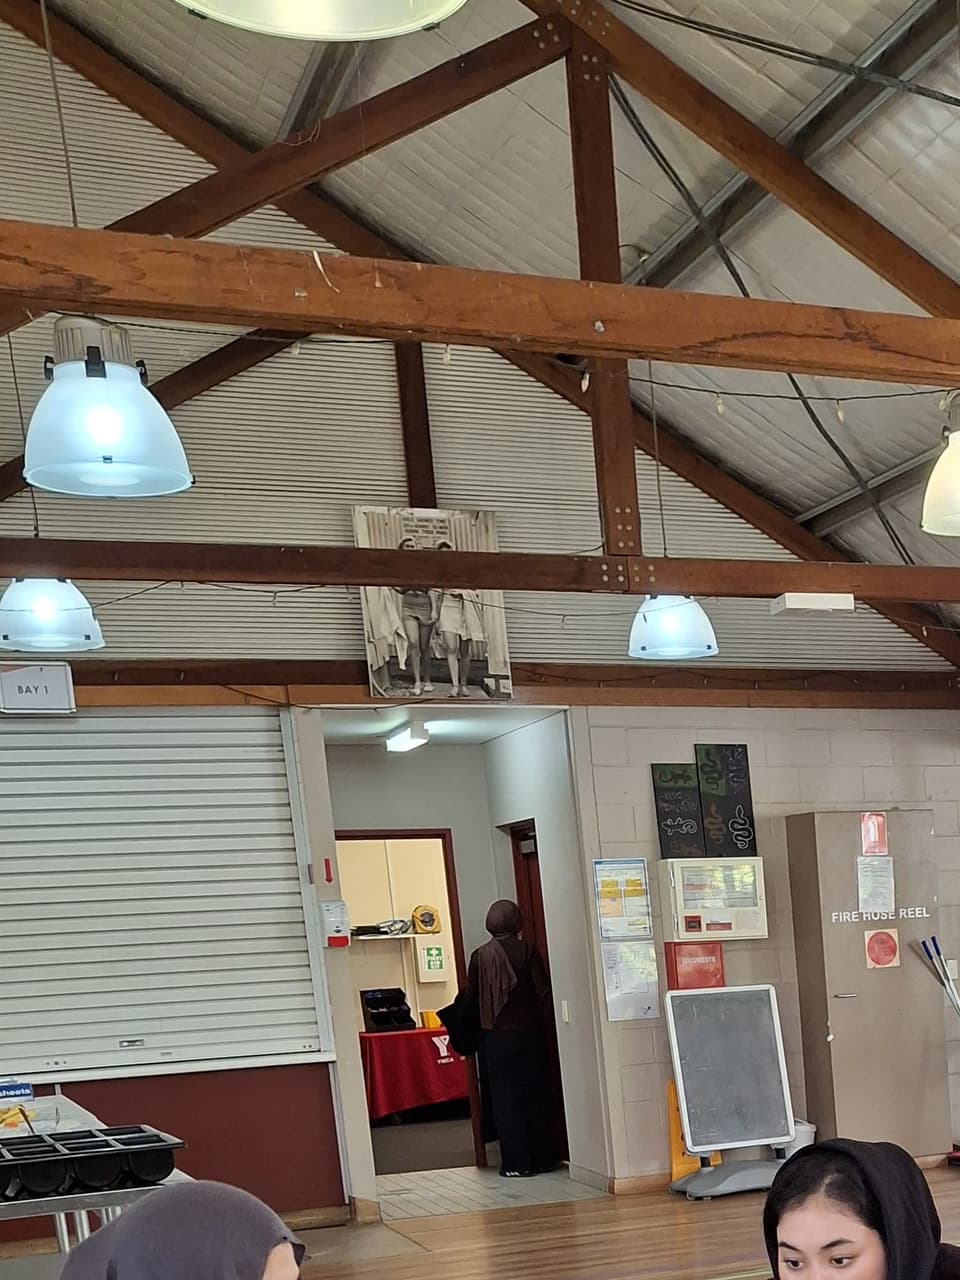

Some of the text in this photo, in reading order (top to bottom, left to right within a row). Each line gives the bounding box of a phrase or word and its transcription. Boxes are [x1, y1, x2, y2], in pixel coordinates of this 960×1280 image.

[17, 685, 49, 695] BAY 1
[832, 907, 930, 923] FIRE HOSE REEL
